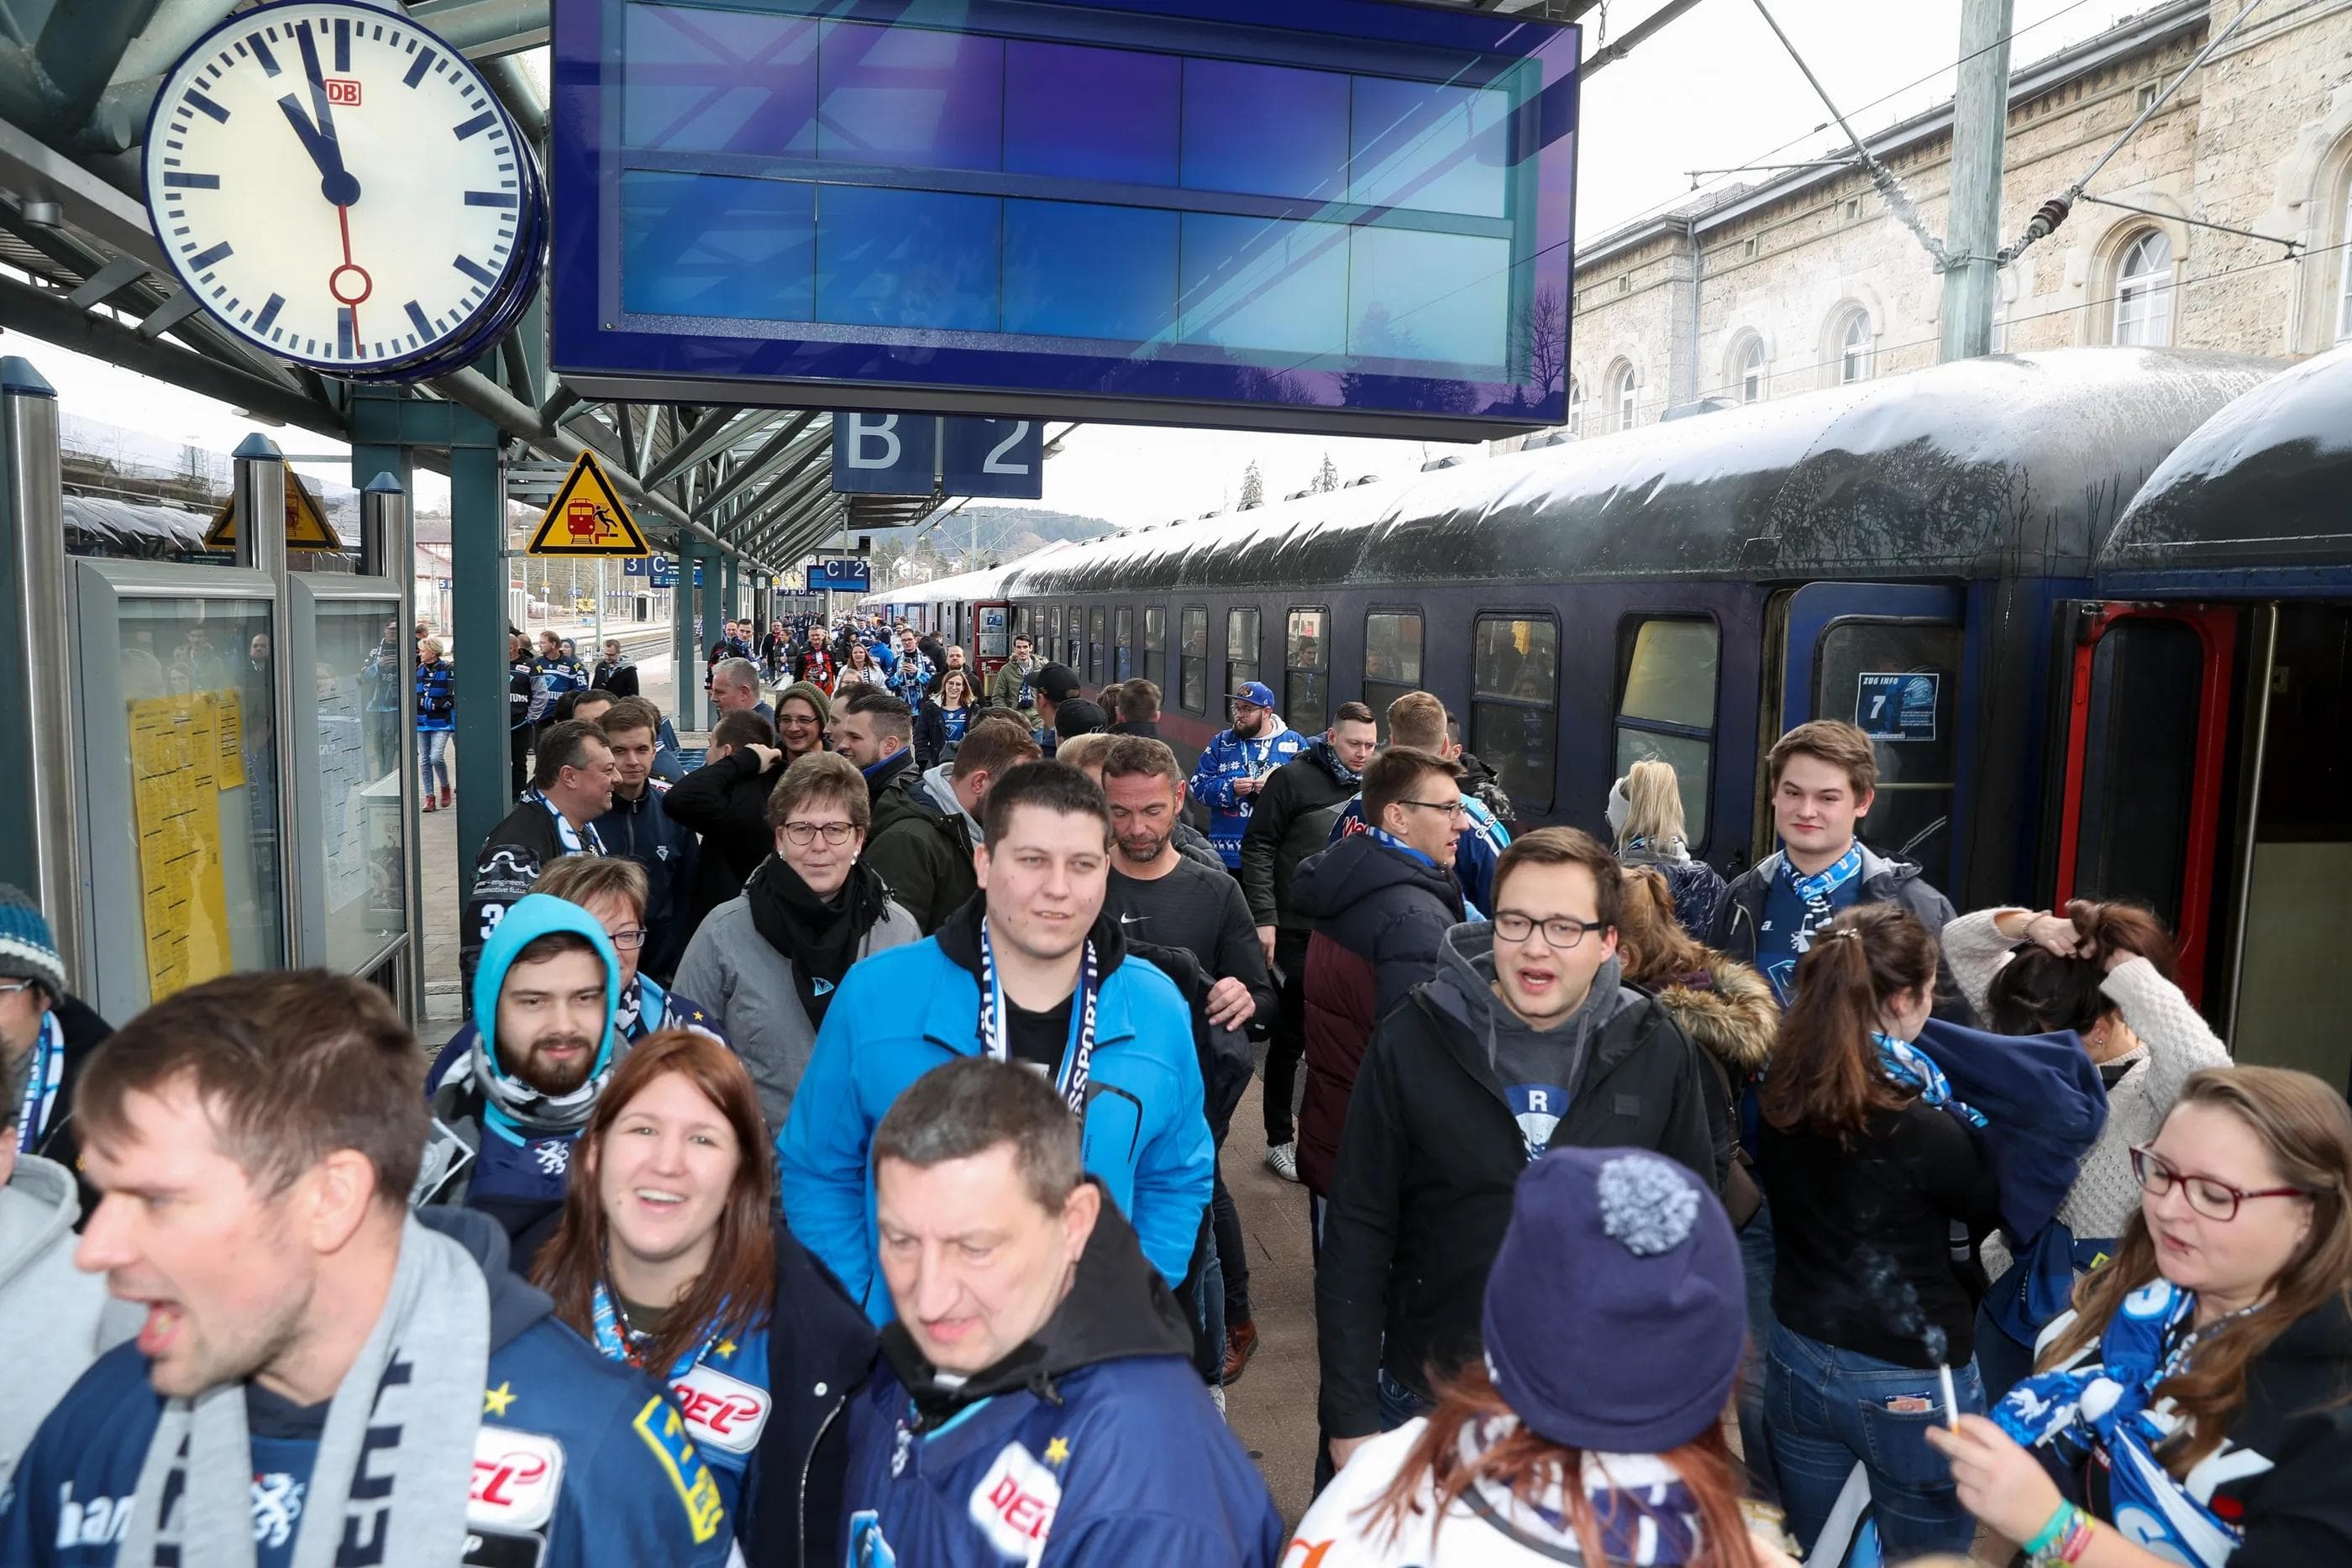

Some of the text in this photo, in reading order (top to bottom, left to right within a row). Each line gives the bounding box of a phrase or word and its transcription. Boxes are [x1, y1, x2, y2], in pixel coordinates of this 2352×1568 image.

[328, 82, 358, 102] DB
[848, 412, 901, 469] B
[982, 418, 1030, 475] 2
[627, 557, 638, 572] 3
[653, 556, 666, 573] C
[827, 560, 839, 577] C
[853, 561, 864, 577] 2
[585, 647, 591, 656] H
[1862, 676, 1899, 685] ZUG INFO
[1870, 695, 1887, 720] 7
[1528, 1089, 1548, 1112] R
